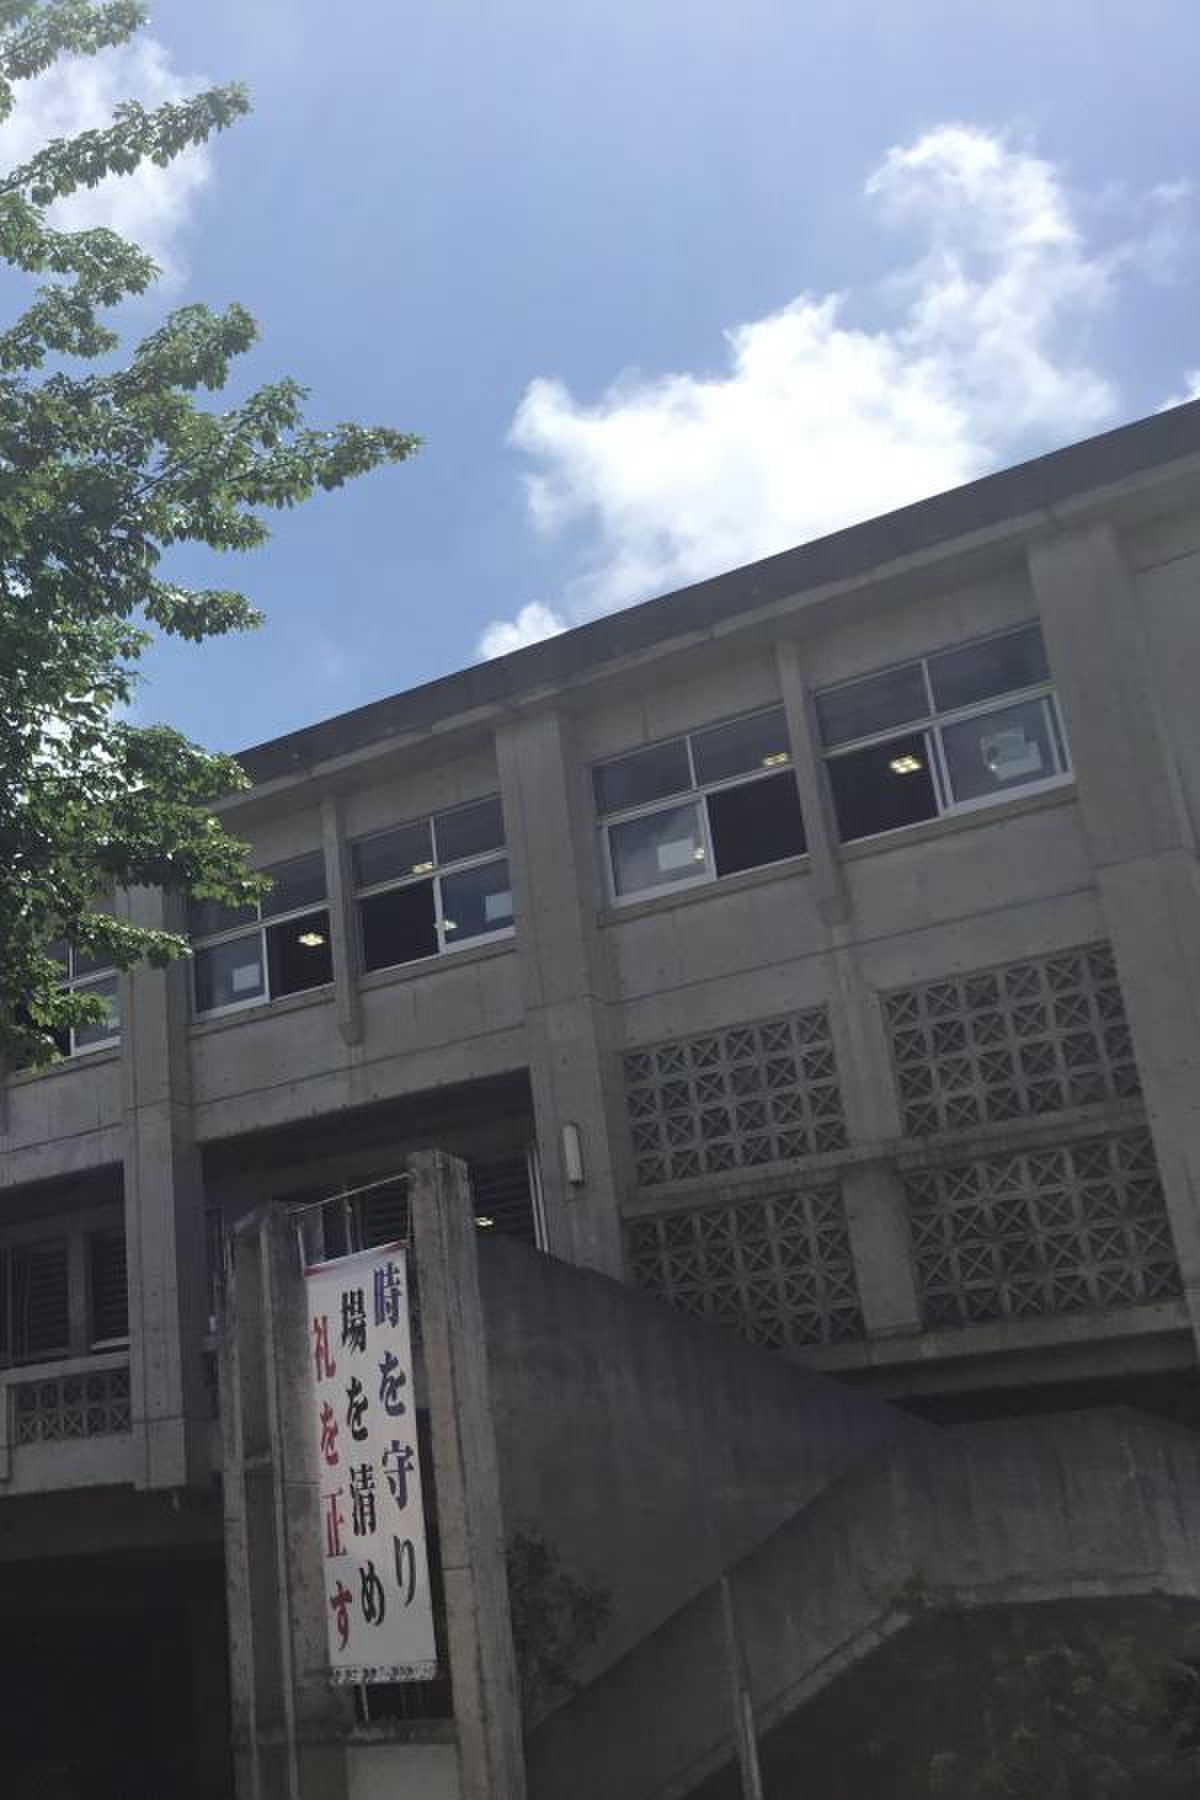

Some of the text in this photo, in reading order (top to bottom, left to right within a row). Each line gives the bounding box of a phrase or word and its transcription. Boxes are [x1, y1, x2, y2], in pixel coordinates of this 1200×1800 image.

[312, 1315, 353, 1652] 礼を正す
[341, 1287, 386, 1627] 場を清め
[373, 1261, 415, 1608] 時を守り
